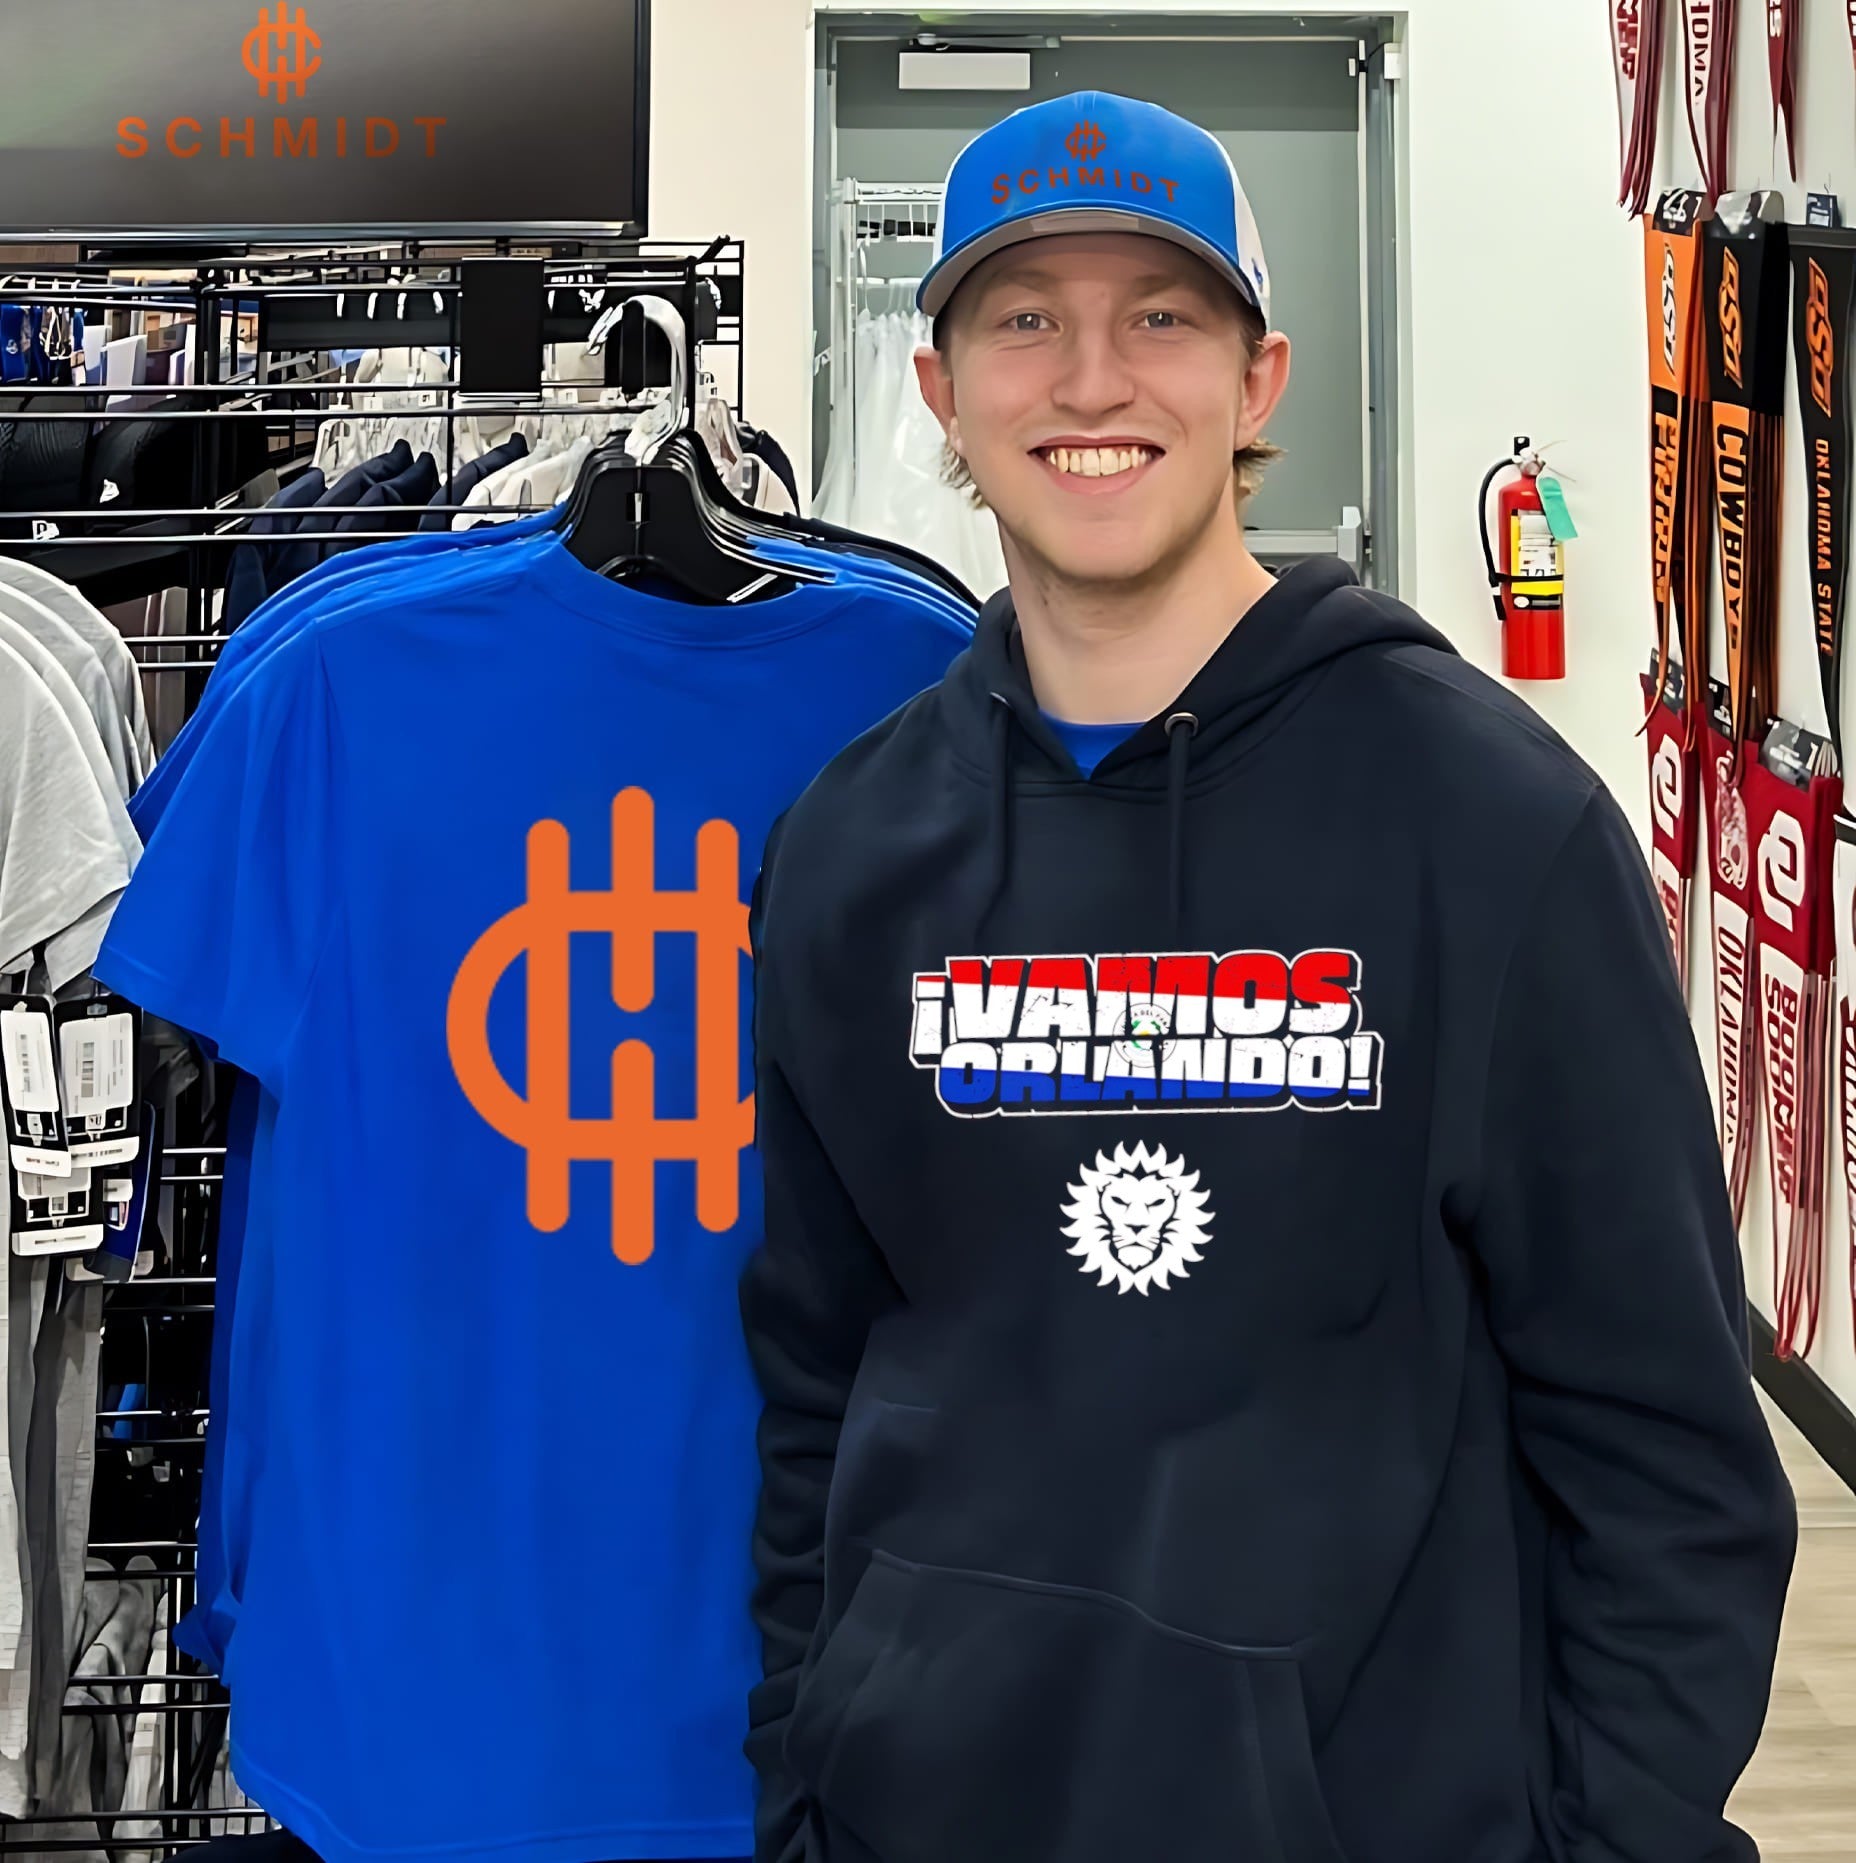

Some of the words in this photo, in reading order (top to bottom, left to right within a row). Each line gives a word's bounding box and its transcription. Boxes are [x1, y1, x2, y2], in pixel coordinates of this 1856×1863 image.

[115, 116, 448, 159] SCHMIDT
[991, 166, 1180, 205] SCHMIDT
[1815, 437, 1832, 570] OKLAHOMA
[1757, 808, 1807, 933] OU
[937, 1034, 1378, 1108] ORLANDO!
[1718, 925, 1746, 1144] OKLAHOMA
